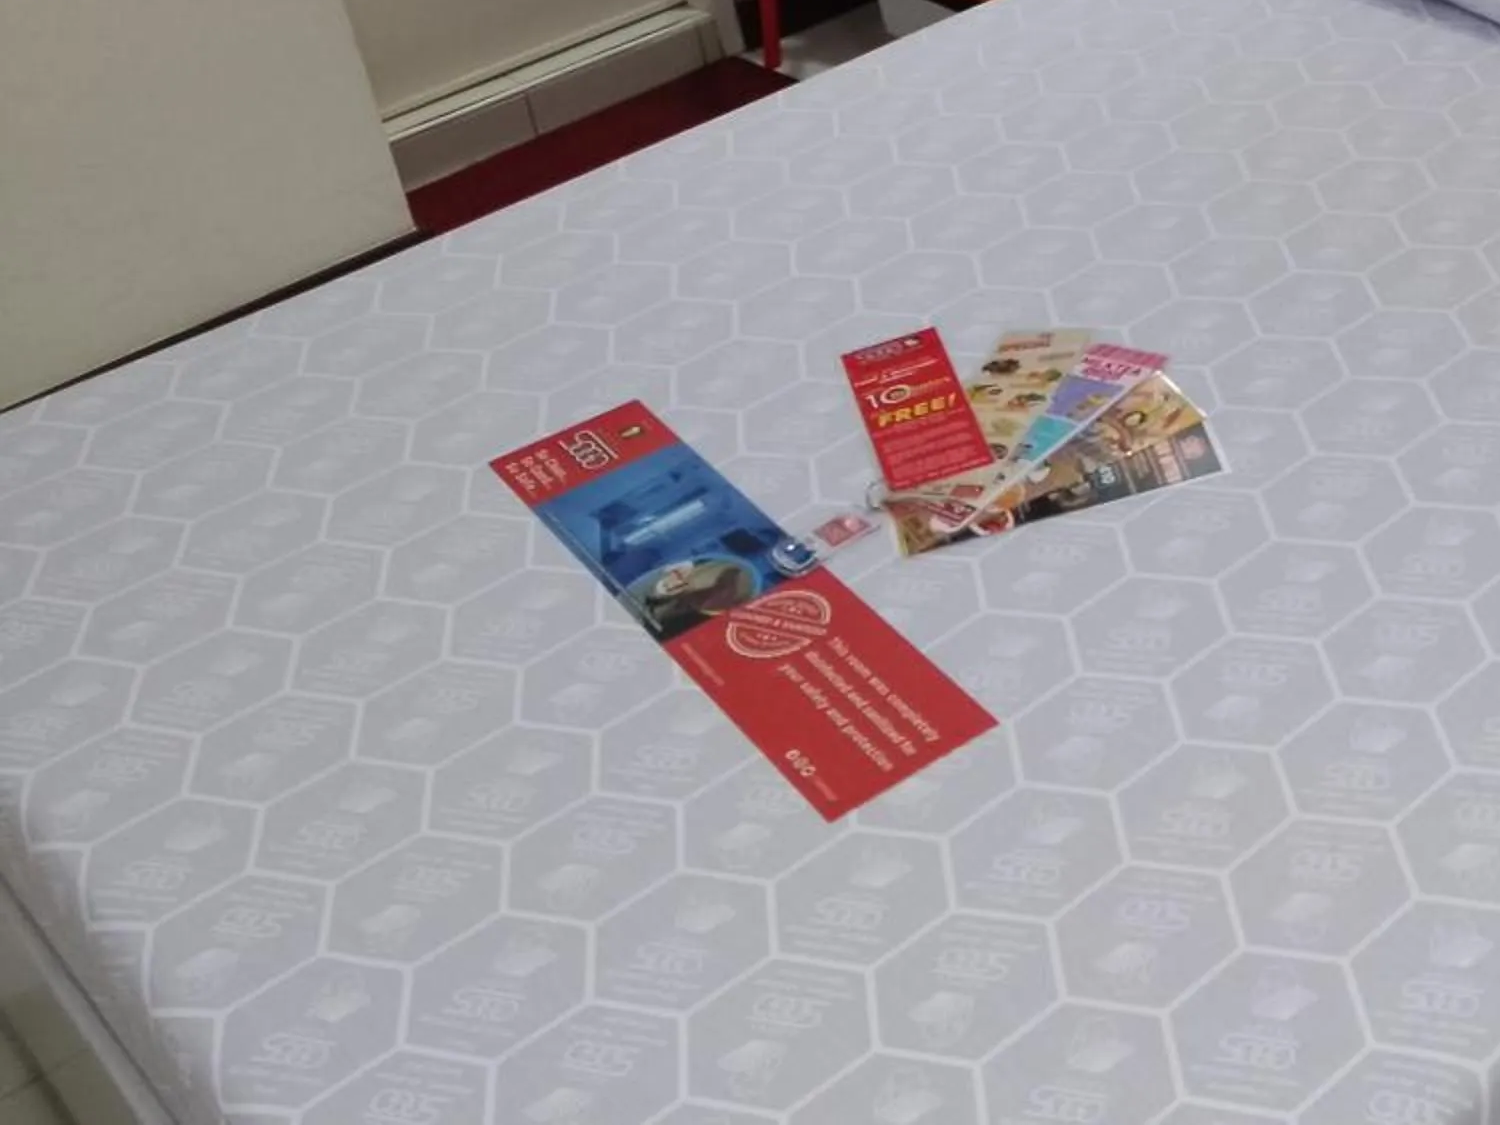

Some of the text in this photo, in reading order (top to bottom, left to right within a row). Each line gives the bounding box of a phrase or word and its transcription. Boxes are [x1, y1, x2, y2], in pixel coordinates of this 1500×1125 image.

[878, 392, 956, 428] FREE!
[777, 664, 894, 772] your safety and protection
[828, 636, 940, 742] This room was completely
[849, 691, 869, 709] and
